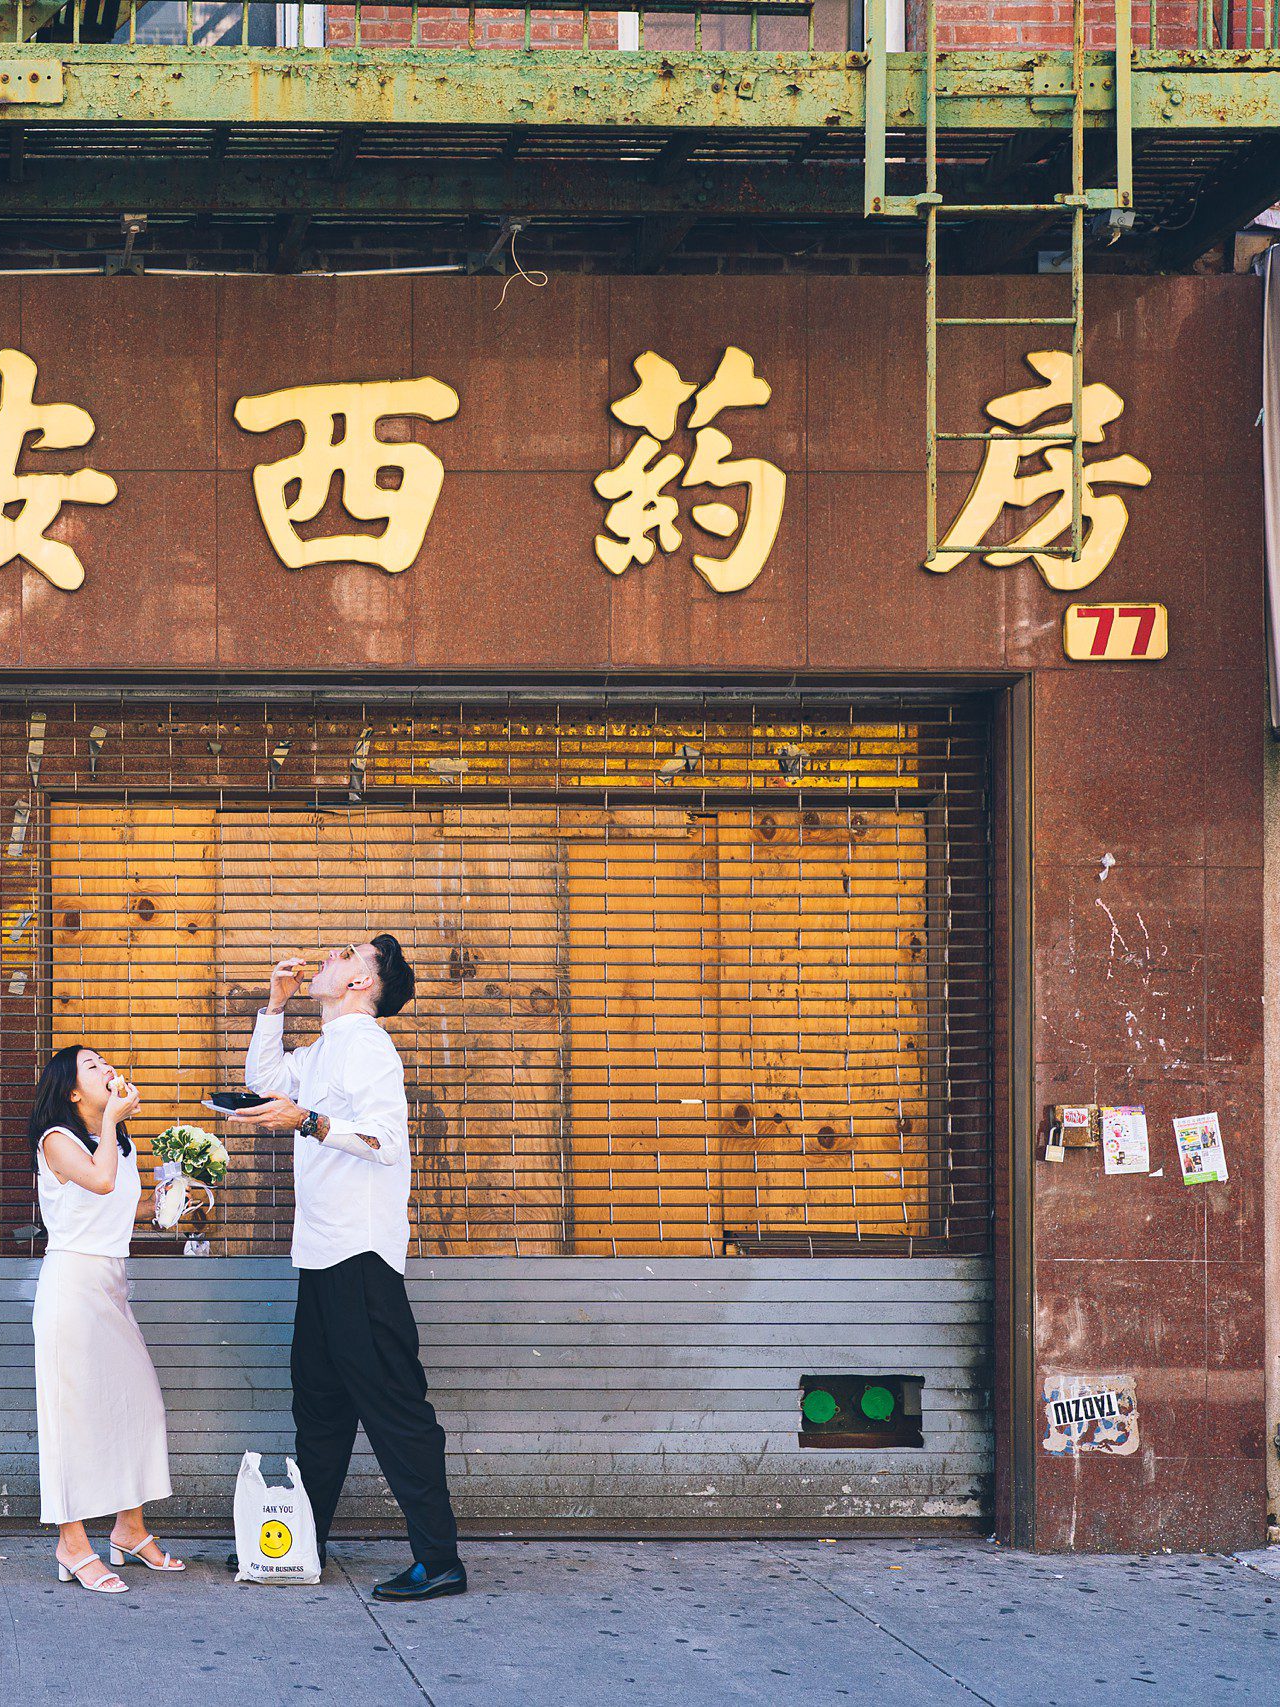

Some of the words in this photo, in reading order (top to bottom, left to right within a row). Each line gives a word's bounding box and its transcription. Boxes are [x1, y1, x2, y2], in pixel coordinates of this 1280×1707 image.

[1077, 608, 1156, 656] 77
[1053, 1394, 1116, 1425] TADZIU
[278, 1505, 294, 1514] YOU
[275, 1565, 305, 1573] BUSINESS
